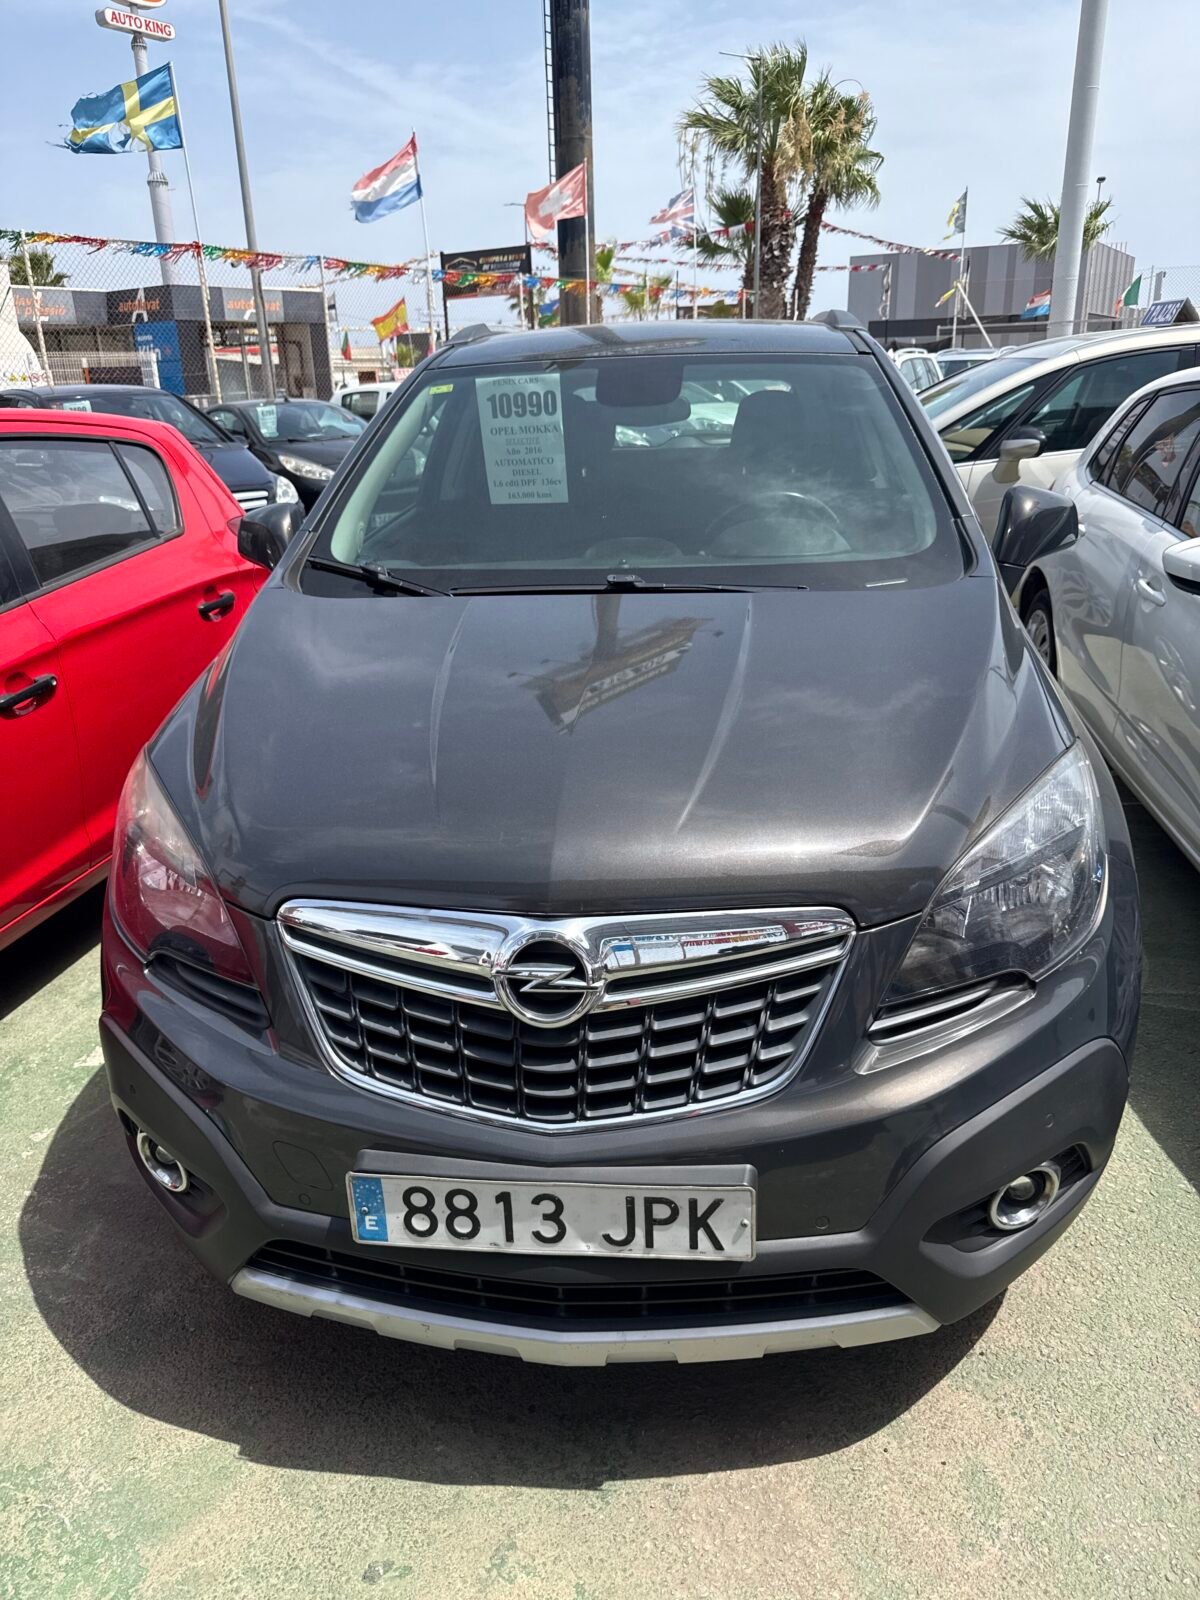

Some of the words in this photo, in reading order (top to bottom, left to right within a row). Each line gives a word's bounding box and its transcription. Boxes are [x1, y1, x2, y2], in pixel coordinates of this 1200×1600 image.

[111, 11, 142, 29] AUTO
[144, 19, 172, 36] KING
[1149, 302, 1181, 322] PLAZAS
[518, 377, 540, 385] CARS
[486, 390, 558, 419] 10990
[490, 426, 518, 436] OPEL
[519, 424, 559, 434] MOKKA
[524, 446, 543, 455] 2016
[494, 456, 554, 467] AUTOMATICO
[512, 468, 543, 477] DIESEL
[521, 479, 537, 487] DPF
[364, 1215, 379, 1231] E
[402, 1185, 567, 1245] 8813
[602, 1195, 726, 1252] JPK
